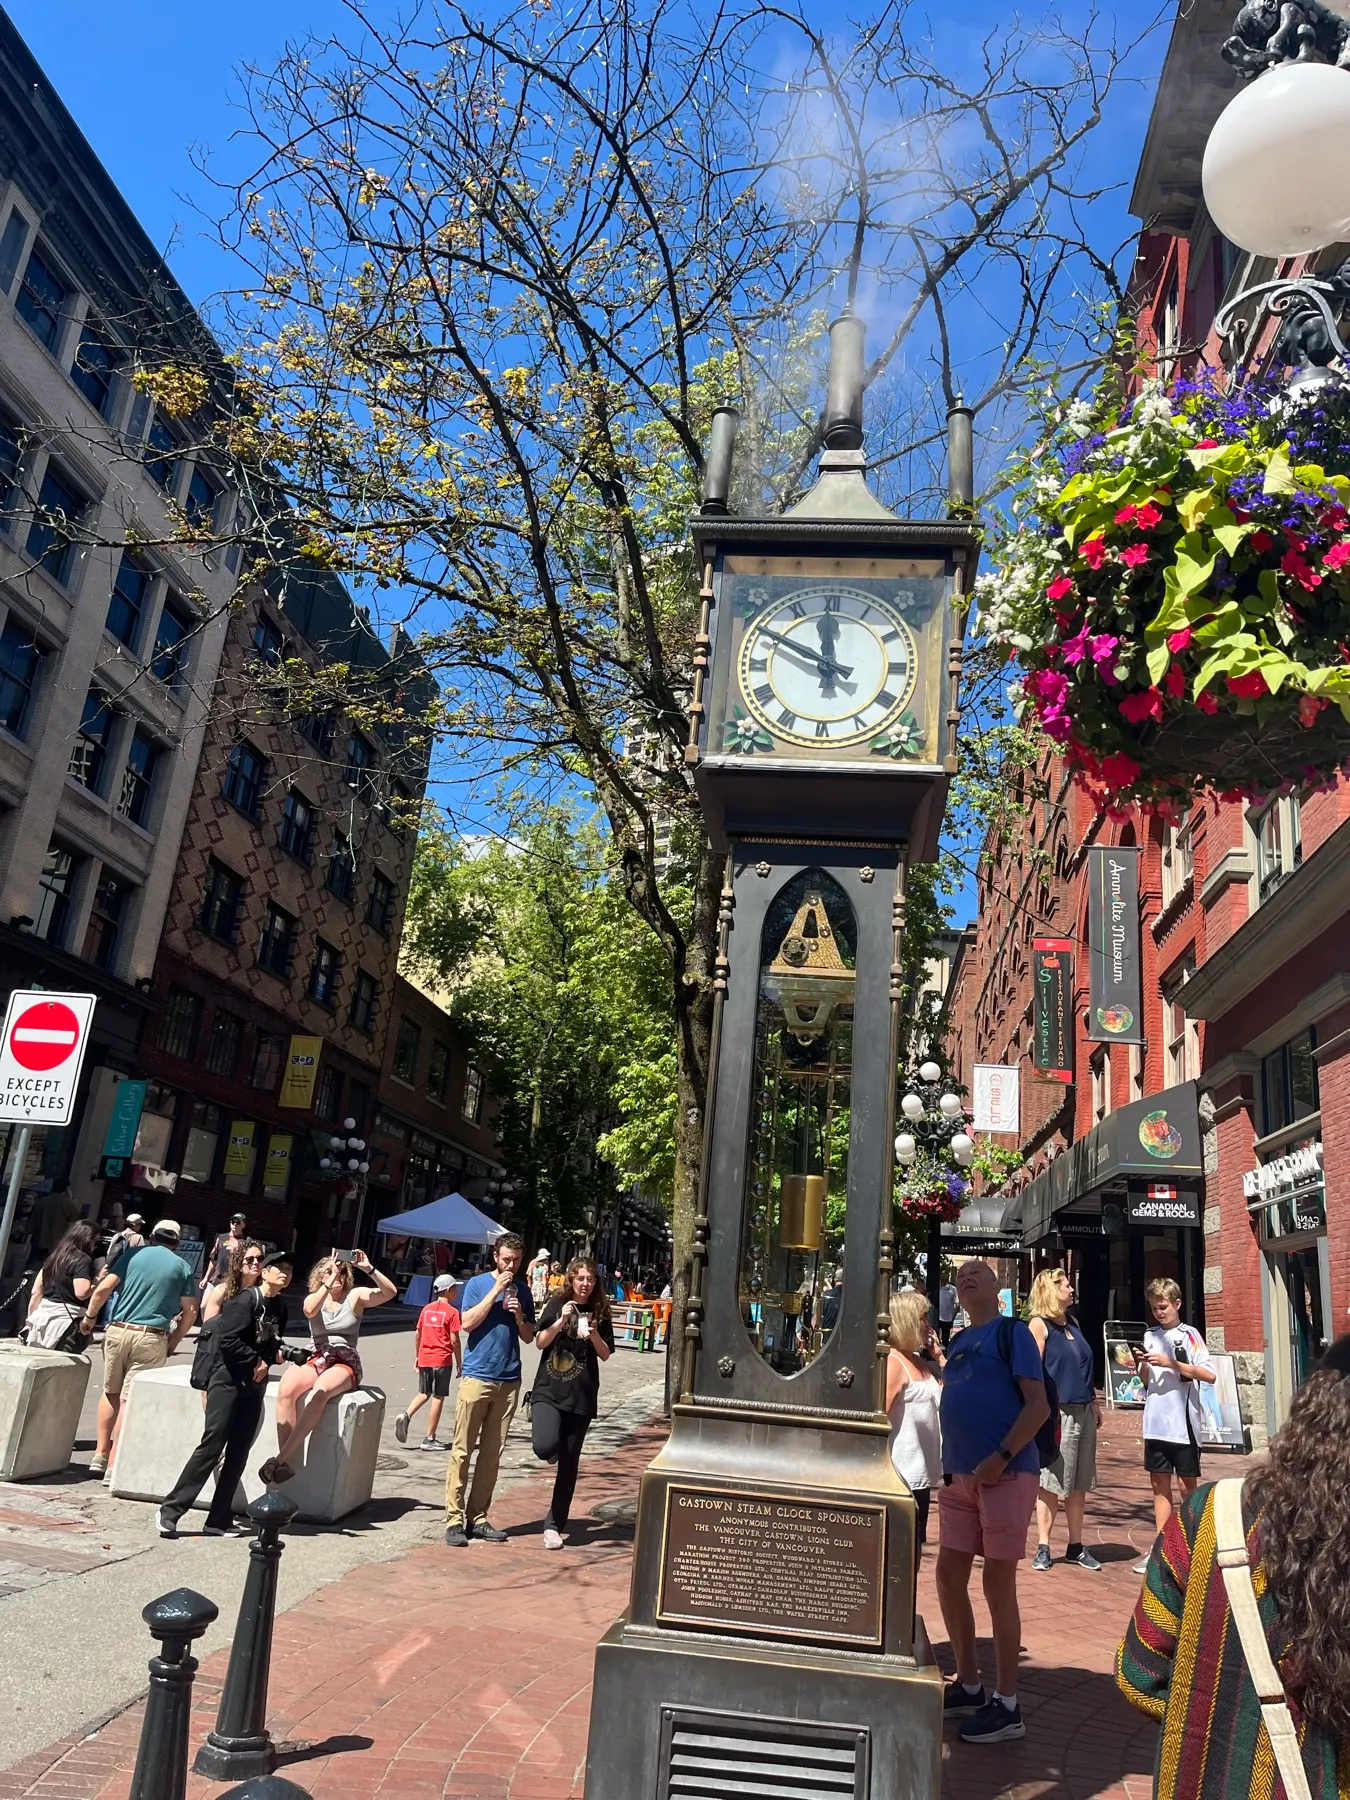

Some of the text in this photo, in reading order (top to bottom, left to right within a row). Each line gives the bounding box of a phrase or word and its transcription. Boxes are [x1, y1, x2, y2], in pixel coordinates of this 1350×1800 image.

[888, 662, 907, 674] III
[1112, 924, 1126, 984] Museum
[1038, 968, 1052, 1066] Silvestre
[6, 1078, 61, 1092] EXCEPT
[111, 1084, 141, 1152] Silver Gallery
[1132, 1208, 1156, 1217] GEMS
[1166, 1210, 1196, 1218] ROCKS
[1139, 1202, 1186, 1211] CANADIAN
[956, 1225, 970, 1233] 321
[679, 1497, 872, 1527] GASTOWN STEAM CLOCK SPONSORS
[720, 1516, 828, 1535] ANONYMOUS CONTRIBUTOR
[694, 1524, 853, 1548] THE VANCOUVER GASTOWN LIONS CLUB
[699, 1546, 725, 1554] GASTOWN
[728, 1549, 753, 1557] HISTORIC
[782, 1555, 820, 1564] WOODWARD'S
[720, 1537, 826, 1555] THE CITY OF VANCOUVER
[674, 1557, 717, 1567] CHARTERHOUSE
[719, 1562, 752, 1571] PROPERTIES
[770, 1568, 796, 1576] CENTRAL
[816, 1573, 854, 1582] DISTRIBUTION
[680, 1551, 710, 1559] MARATHON
[712, 1554, 736, 1562] PROJECT
[811, 1565, 837, 1573] PATRICIA
[673, 1570, 700, 1578] GEORGINA
[757, 1580, 796, 1589] MANAGEMENT
